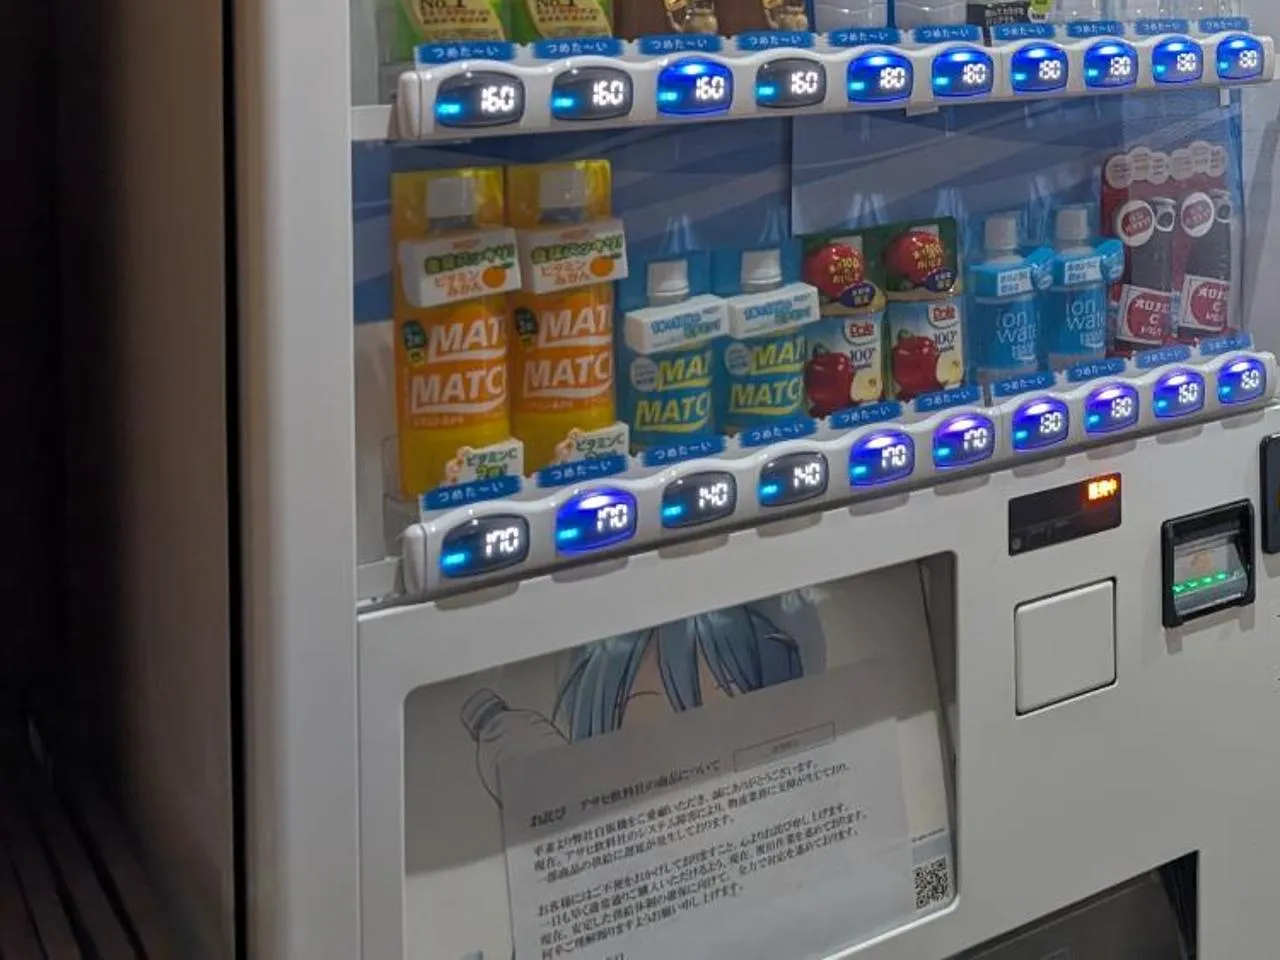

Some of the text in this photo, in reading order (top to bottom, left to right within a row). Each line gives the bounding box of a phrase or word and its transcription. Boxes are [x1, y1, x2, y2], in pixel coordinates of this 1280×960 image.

[593, 80, 624, 106] 160
[695, 75, 724, 100] 160
[790, 71, 818, 95] 160
[480, 86, 515, 113] 160
[962, 426, 988, 452] 170
[881, 444, 906, 468] 170
[793, 462, 821, 488] 140
[698, 483, 728, 508] 140
[597, 503, 628, 532] 170
[486, 526, 519, 556] 170
